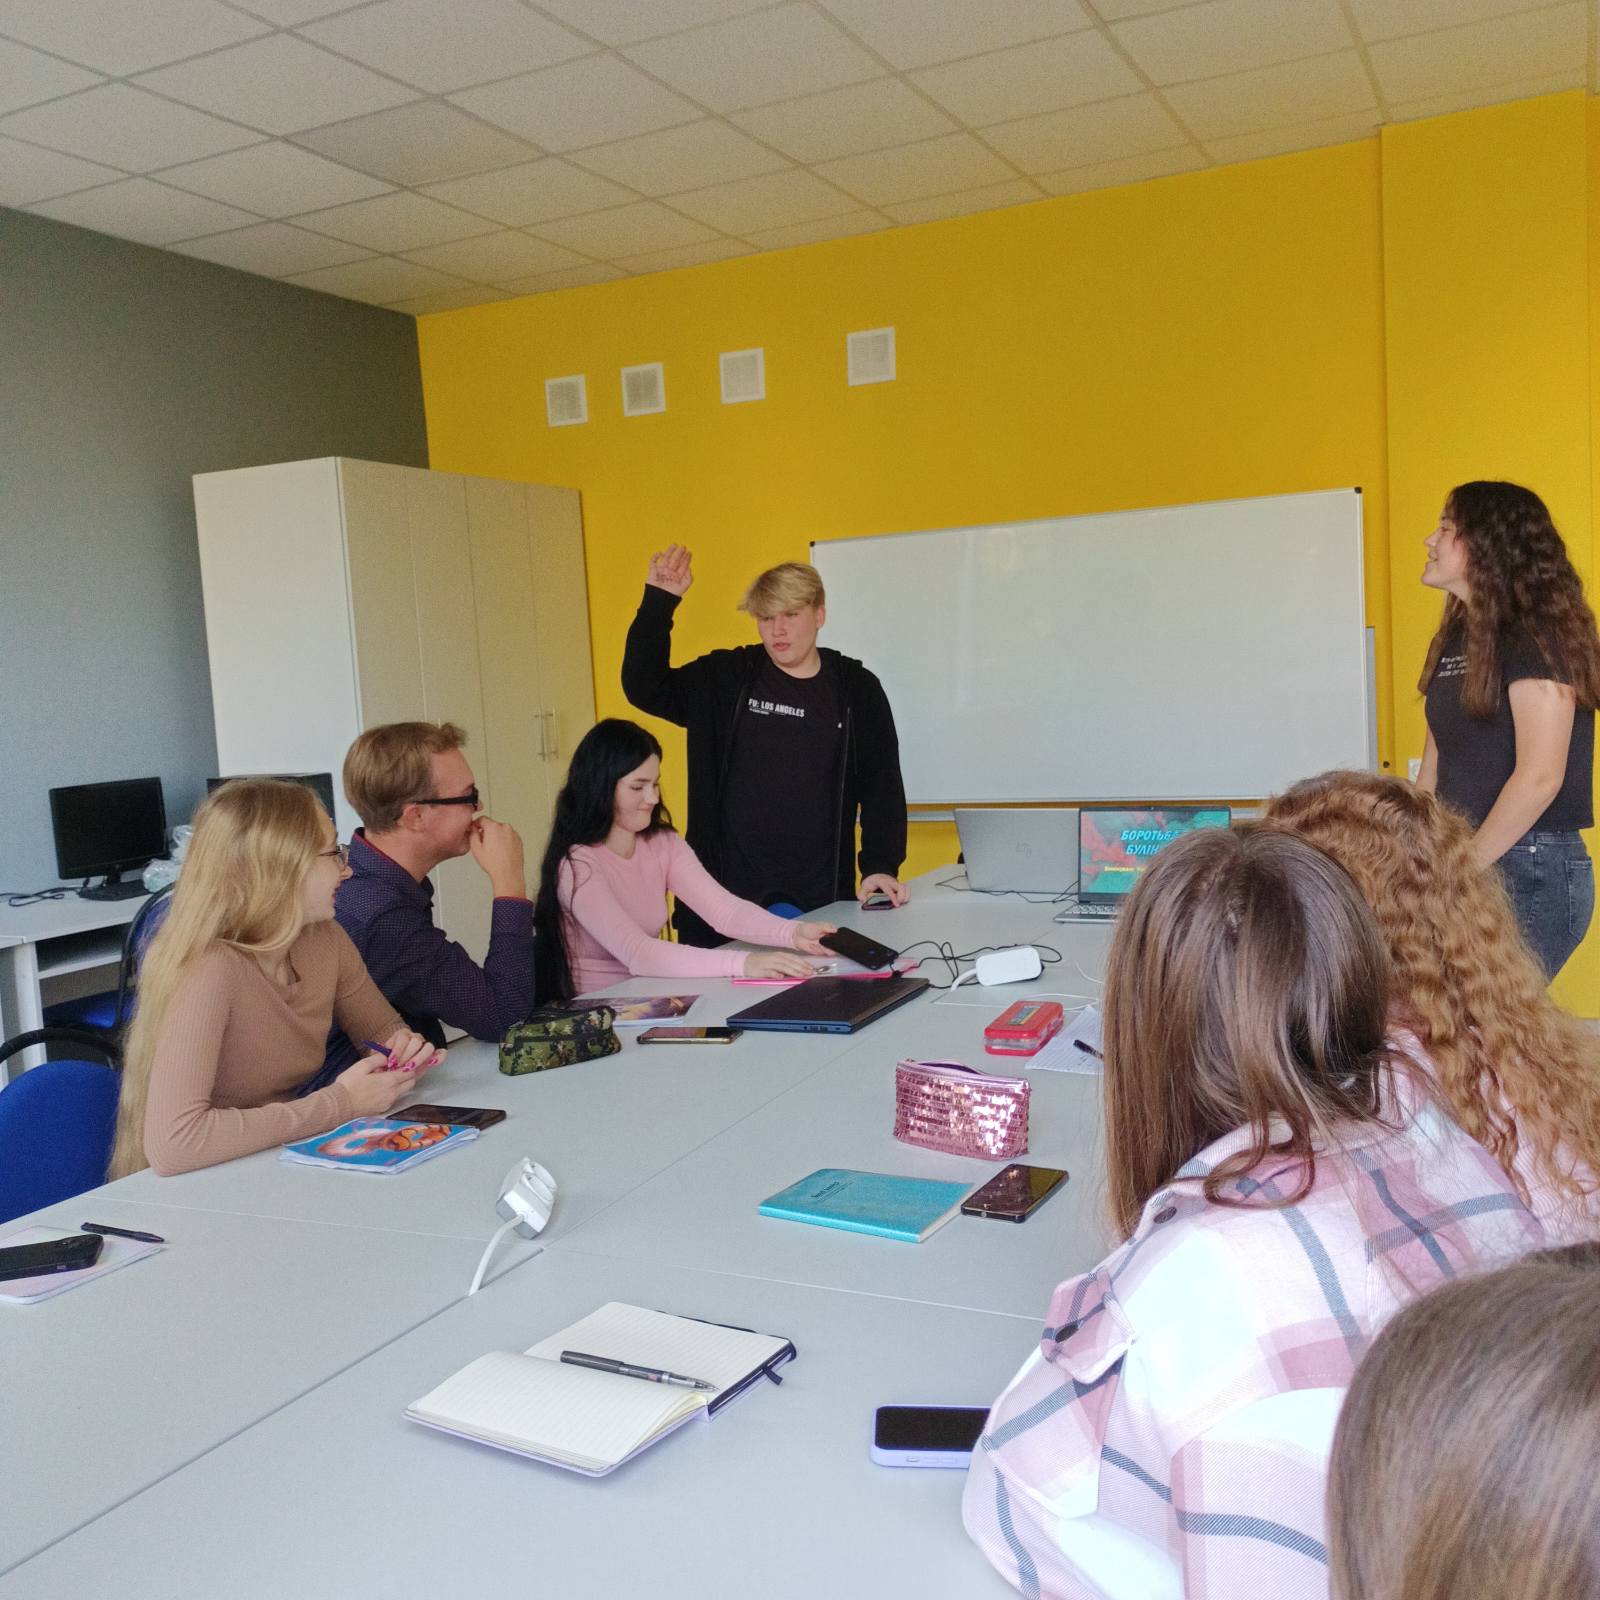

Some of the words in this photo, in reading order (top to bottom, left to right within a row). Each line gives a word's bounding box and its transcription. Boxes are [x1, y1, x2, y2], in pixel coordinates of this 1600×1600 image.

[761, 700, 774, 711] LOS
[775, 703, 805, 718] ANGELES
[1126, 844, 1160, 856] БУЛІН
